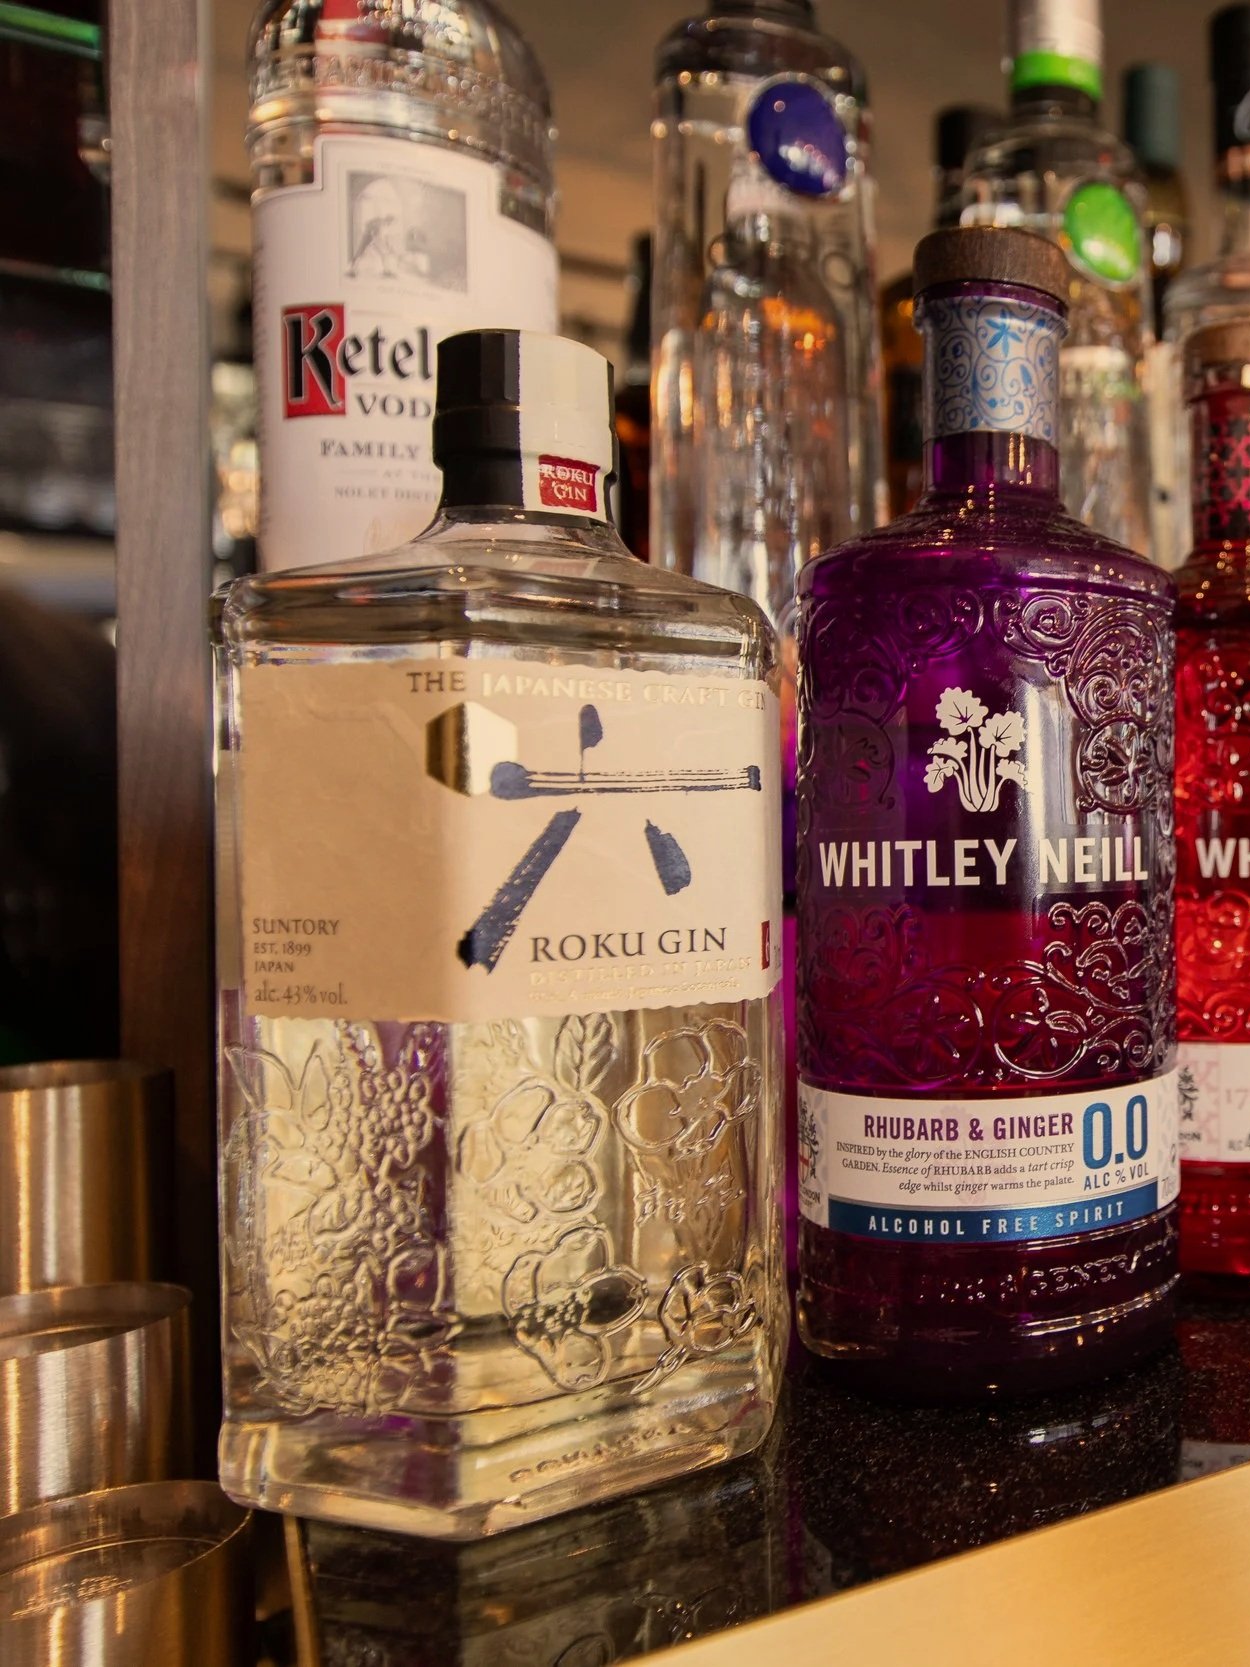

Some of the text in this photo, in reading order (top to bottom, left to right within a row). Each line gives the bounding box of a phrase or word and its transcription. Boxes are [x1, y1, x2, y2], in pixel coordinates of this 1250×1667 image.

[285, 309, 433, 410] Ketel
[356, 393, 432, 420] VOD
[320, 438, 419, 459] FAMILY
[539, 464, 594, 486] ROKU
[551, 483, 587, 501] GIN
[407, 671, 465, 693] THE
[481, 673, 632, 702] JAPANESE
[643, 683, 729, 707] CRAFT
[819, 836, 1149, 887] WHITLEY NEILL
[252, 918, 340, 936] SUNTORY
[253, 941, 312, 957] EST. 1899
[530, 926, 728, 962] ROKU GIN
[254, 961, 295, 973] JAPAN
[529, 963, 654, 986] DISTILLED
[694, 956, 752, 977] JAPAN
[282, 984, 317, 1005] 43%
[319, 981, 348, 1005] vol.
[864, 1112, 1074, 1141] RHUBARB & GINGER
[1082, 1094, 1149, 1170] 0.0
[836, 1141, 1075, 1162] INSPIRED by the glory of the ENGLISH COUNTRY
[842, 1158, 1075, 1178] GARDEN. Essence of RHUBARB adds a tart crisp
[1084, 1162, 1150, 1191] ALC % VOL
[898, 1176, 1074, 1195] edge whilst ginger warms the palate.
[868, 1200, 1124, 1236] ALCOHOL FREE SPIRIT
